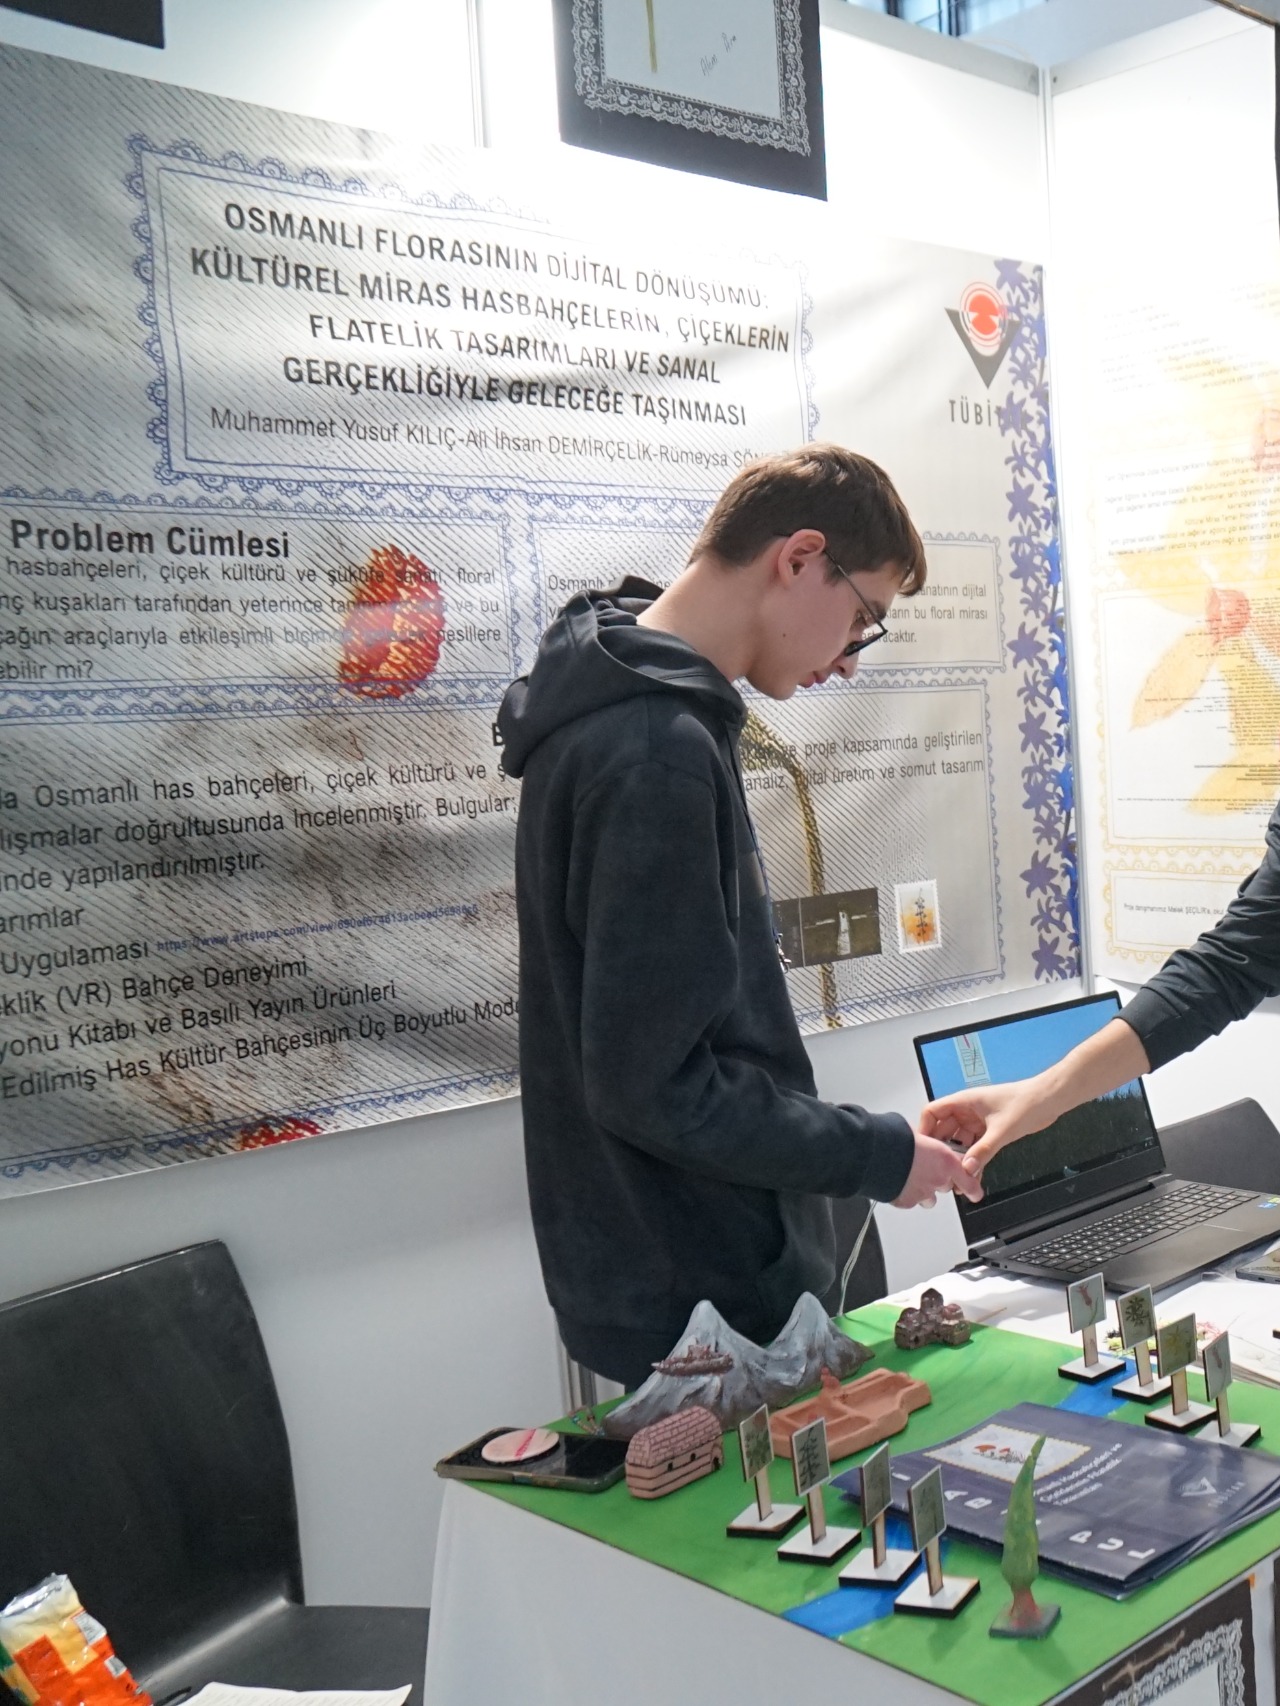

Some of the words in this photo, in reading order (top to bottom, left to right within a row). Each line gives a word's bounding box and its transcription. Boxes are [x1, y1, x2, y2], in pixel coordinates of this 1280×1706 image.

[224, 203, 364, 250] OSMANLI
[375, 228, 538, 273] FLORASININ
[547, 251, 627, 290] DİJİTAL
[636, 269, 769, 309] DÖNÜŞÜMÜ:
[191, 246, 349, 297] KÜLTÜREL
[359, 272, 451, 308] MİRAS
[462, 286, 669, 338] HASBAHÇELERİN,
[677, 313, 789, 353] ÇİÇEKLERİN
[309, 314, 443, 350] FLATELİK
[451, 330, 616, 370] TASARIMLARI
[624, 349, 649, 375] VE
[656, 354, 721, 384] SANAL
[283, 356, 499, 403] GERÇEKLİĞİYLE
[508, 379, 623, 415] GELECEĞE
[632, 393, 746, 426] TAŞINMASI
[210, 407, 336, 438] Muhammet
[342, 418, 399, 442] Yusuf
[495, 427, 542, 453] İhsan
[549, 435, 728, 469] DEMİRÇELİK-Rümeysa
[11, 519, 154, 553] Problem
[167, 526, 290, 558] Cümlesi
[7, 556, 147, 582] hasbahçeleri,
[160, 562, 210, 584] çiçek
[222, 562, 285, 582] kültürü
[297, 568, 316, 582] ve
[457, 567, 495, 584] floral
[33, 591, 126, 615] kuşakları
[135, 593, 233, 612] tarafından
[241, 596, 323, 617] yeterince
[456, 599, 473, 612] ve
[480, 596, 499, 612] bu
[962, 584, 987, 600] dijital
[914, 606, 927, 619] bu
[930, 606, 955, 619] floral
[959, 607, 988, 620] mirası
[64, 626, 168, 650] araçlarıyla
[179, 627, 273, 649] etkileşimli
[436, 627, 501, 642] nesillere
[0, 661, 48, 680] ebilir
[56, 659, 94, 679] mi?
[804, 739, 837, 760] proje
[843, 734, 918, 756] kapsamında
[924, 730, 983, 751] geliştirilen
[34, 780, 139, 808] Osmanlı
[153, 779, 195, 800] has
[207, 770, 314, 800] bahçeleri,
[327, 766, 379, 792] çiçek
[389, 761, 455, 786] kültürü
[465, 764, 486, 779] ve
[832, 767, 875, 783] üretim
[880, 767, 894, 779] ve
[899, 761, 936, 778] somut
[941, 758, 983, 775] tasarım
[0, 823, 101, 854] lışmalar
[115, 811, 284, 845] doğrultusunda
[62, 852, 265, 892] yapılandırılmıştır.
[1, 942, 149, 978] Uygulaması
[57, 980, 112, 1014] (VR)
[122, 972, 194, 1000] Bahçe
[203, 955, 308, 989] Deneyimi
[68, 1021, 136, 1048] Kitabı
[144, 1017, 172, 1035] ve
[181, 1002, 240, 1030] Basılı
[248, 996, 304, 1021] Yayın
[313, 979, 397, 1010] Ürünleri
[1, 1065, 97, 1099] Edilmiş
[106, 1057, 151, 1082] Has
[160, 1041, 226, 1072] Kültür
[236, 1024, 349, 1059] Bahçesinin
[358, 1014, 387, 1040] Üç
[394, 1008, 467, 1034] Boyutlu
